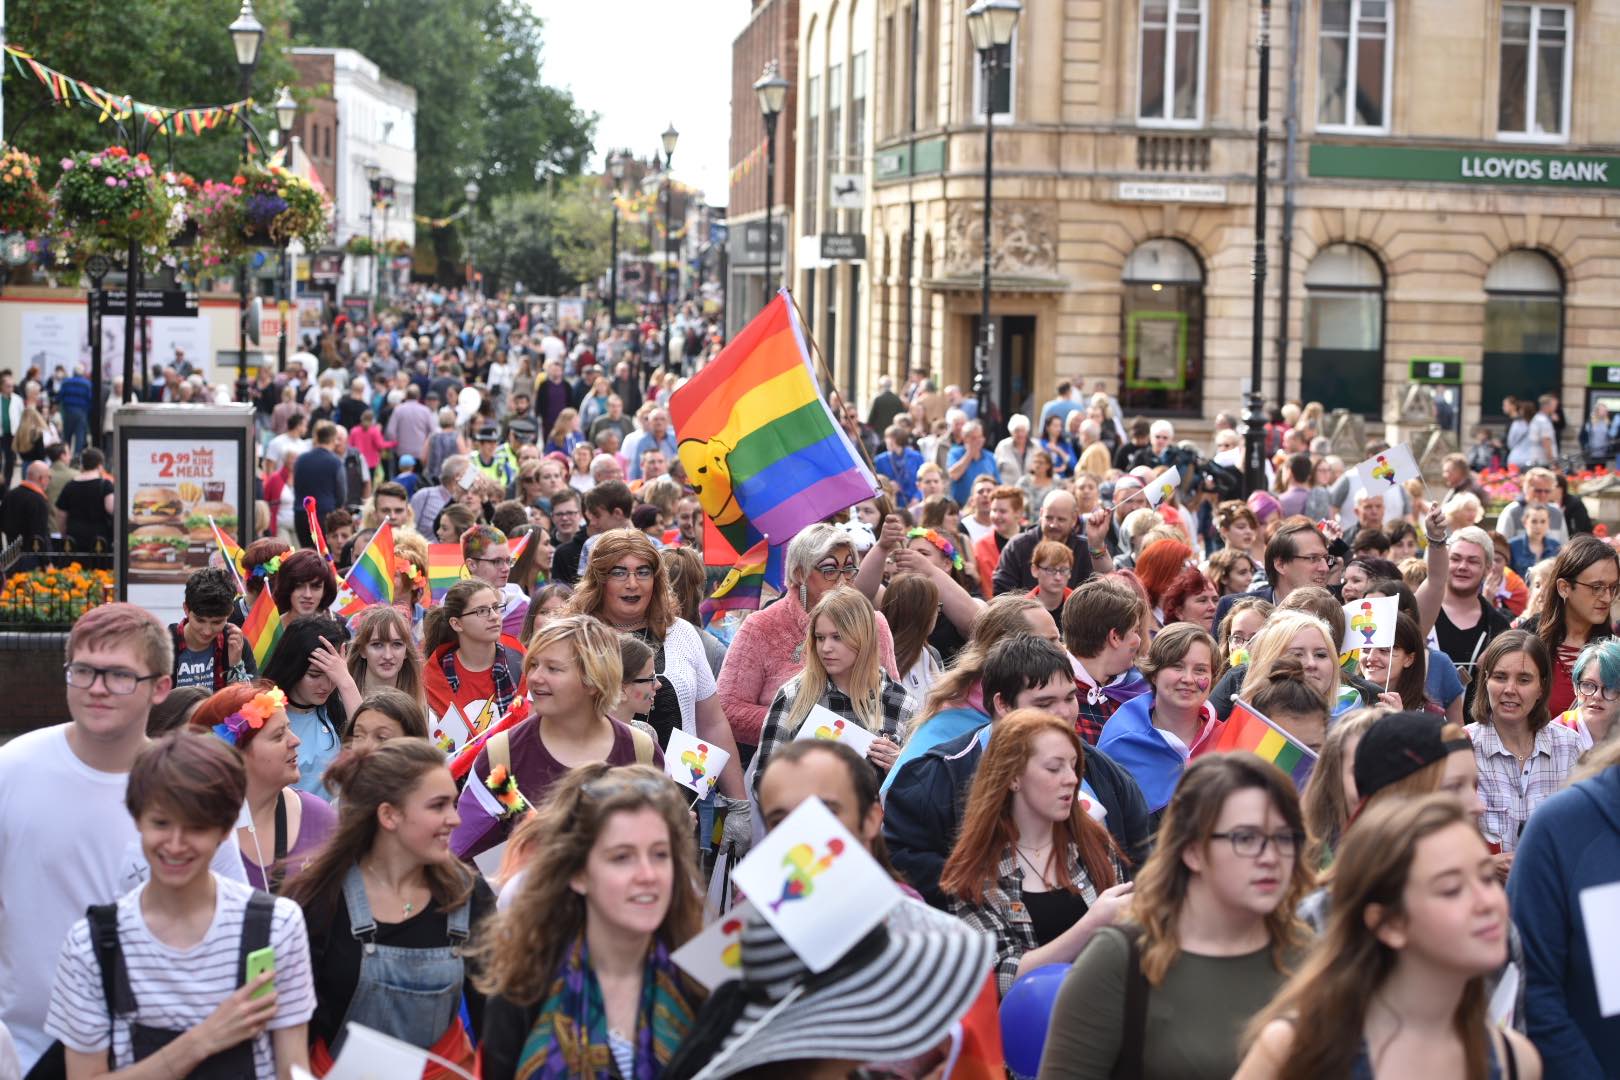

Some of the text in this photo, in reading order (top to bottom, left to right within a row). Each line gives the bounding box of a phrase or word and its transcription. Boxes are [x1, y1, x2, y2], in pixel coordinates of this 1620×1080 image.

[1461, 157, 1608, 182] LLOYDS BANK
[192, 456, 214, 466] KING
[176, 466, 214, 478] MEALS
[178, 662, 205, 676] Am
